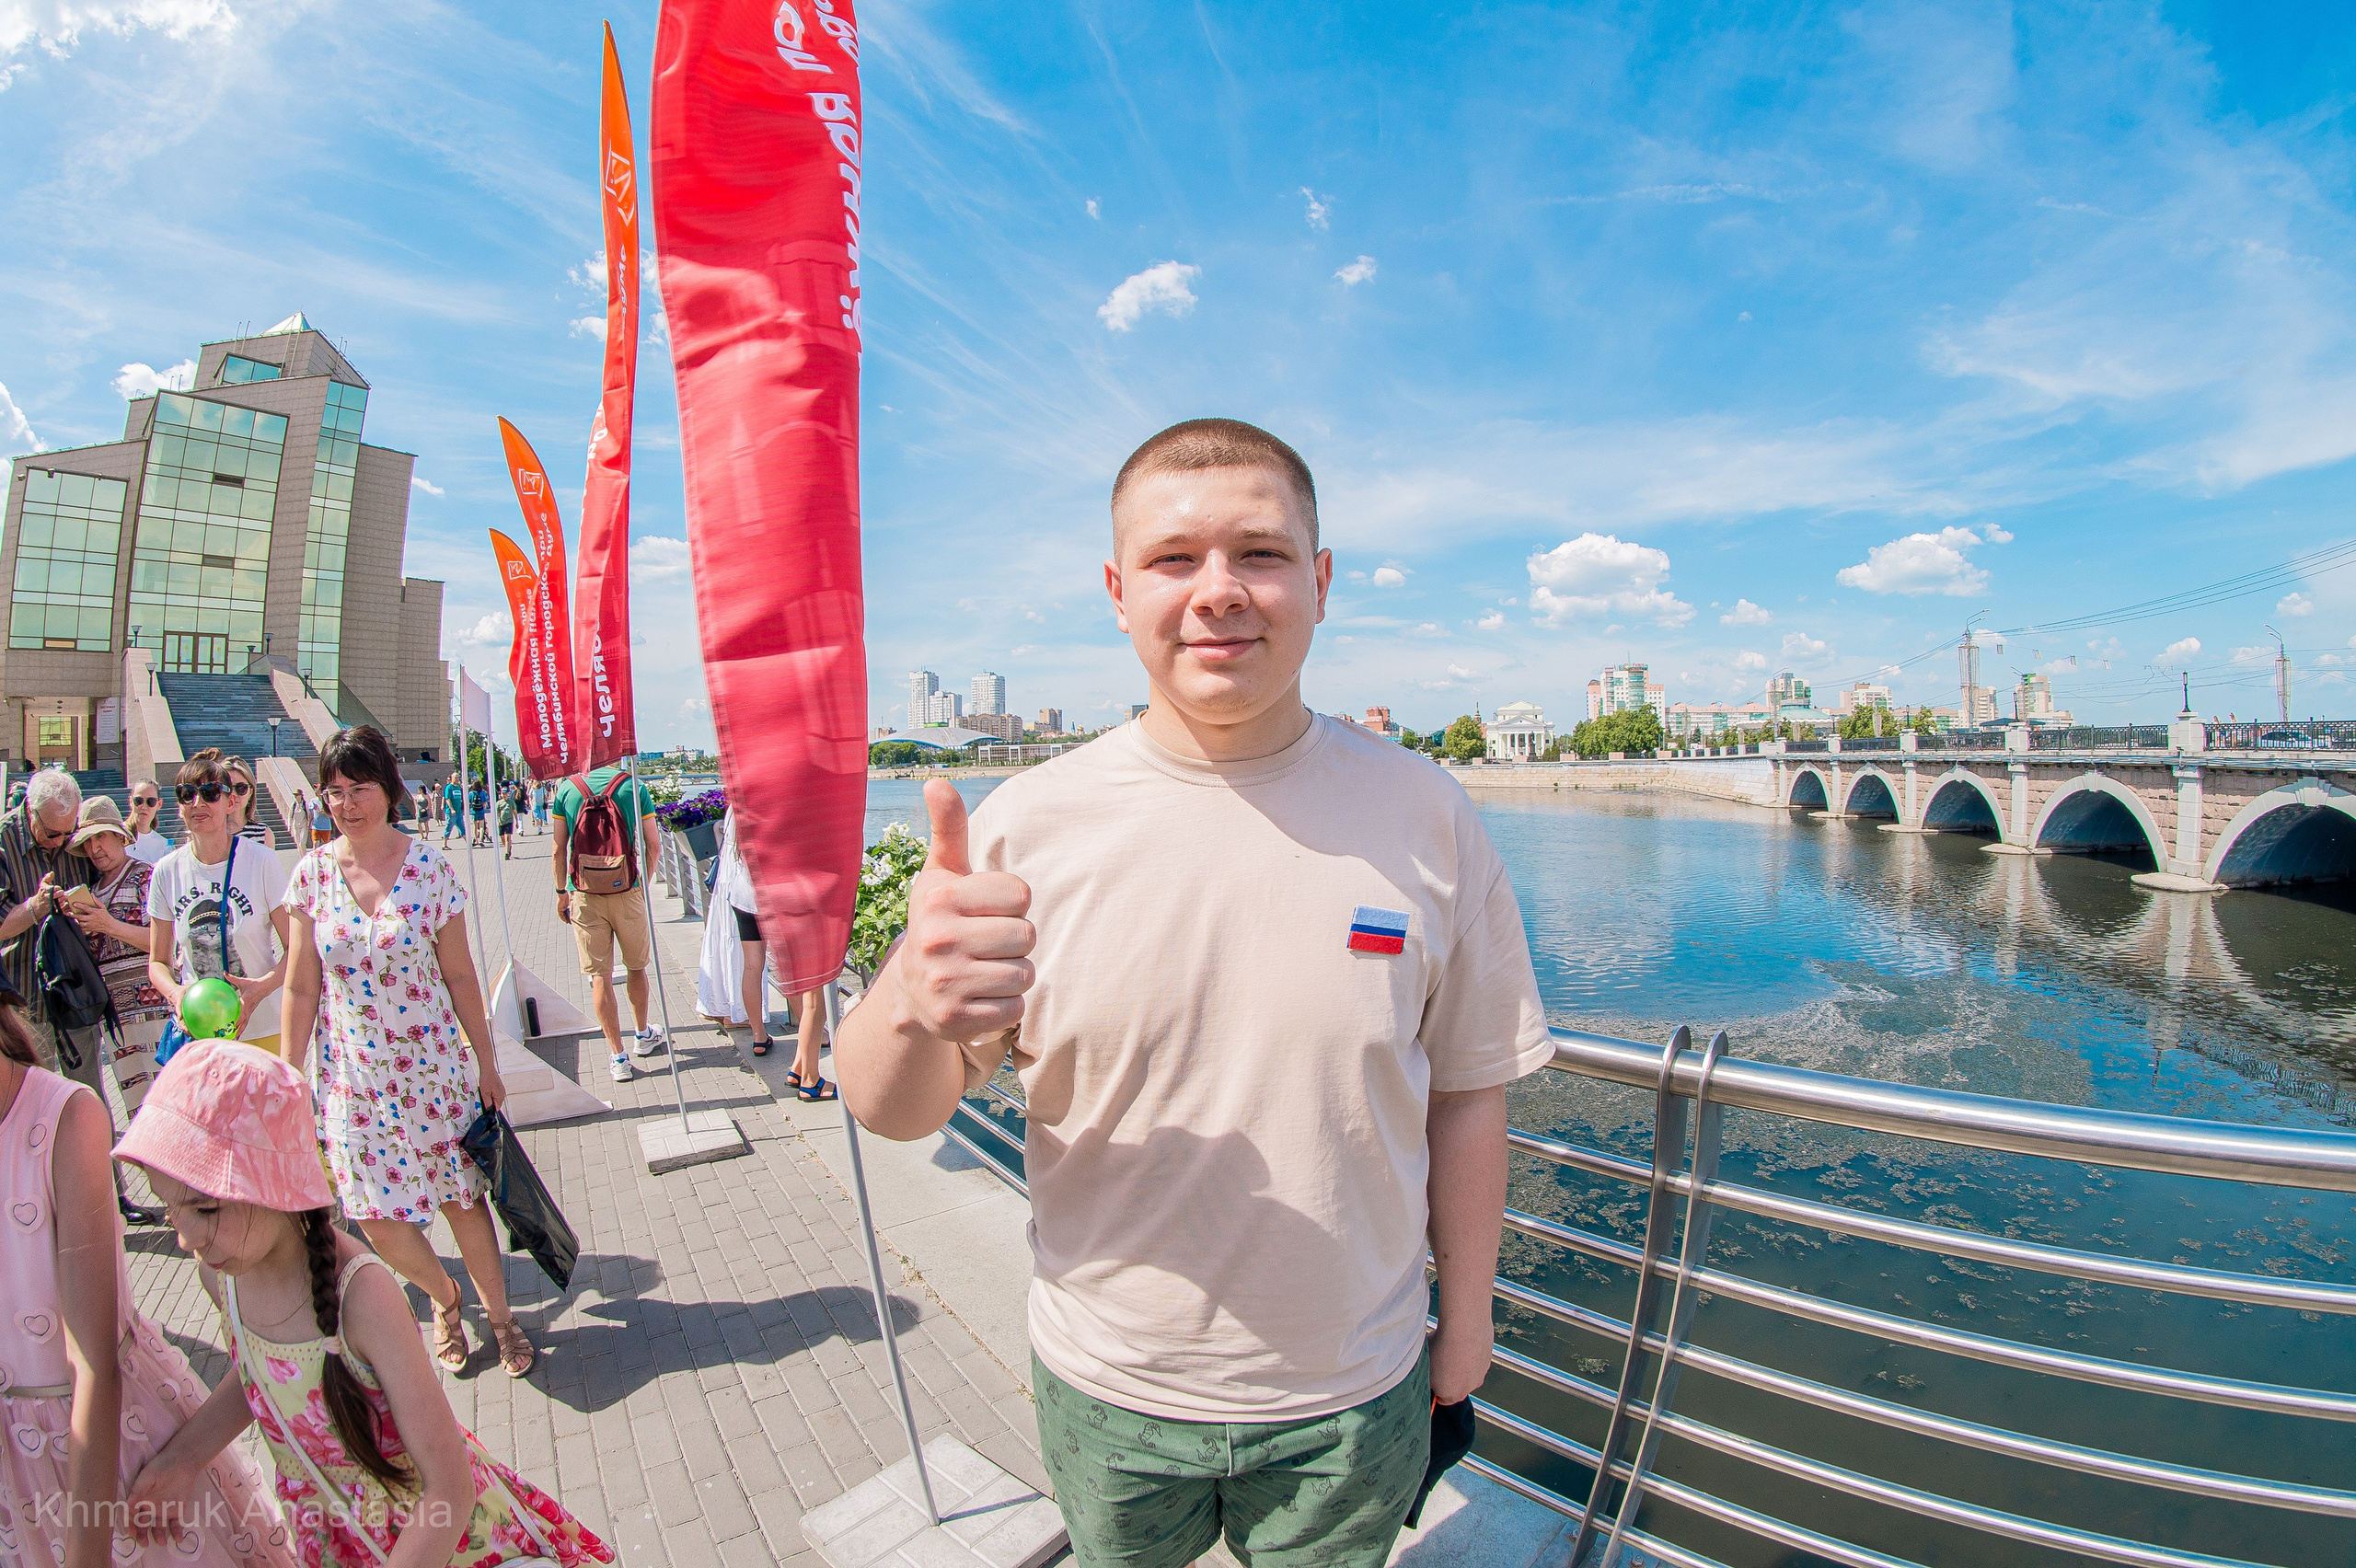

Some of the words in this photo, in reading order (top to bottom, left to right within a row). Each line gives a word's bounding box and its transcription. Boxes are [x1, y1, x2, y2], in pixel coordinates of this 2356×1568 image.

[529, 638, 553, 748] Молодёжная
[545, 651, 568, 764] Челябинской
[175, 885, 204, 921] MRS.
[210, 882, 254, 917] RGHT
